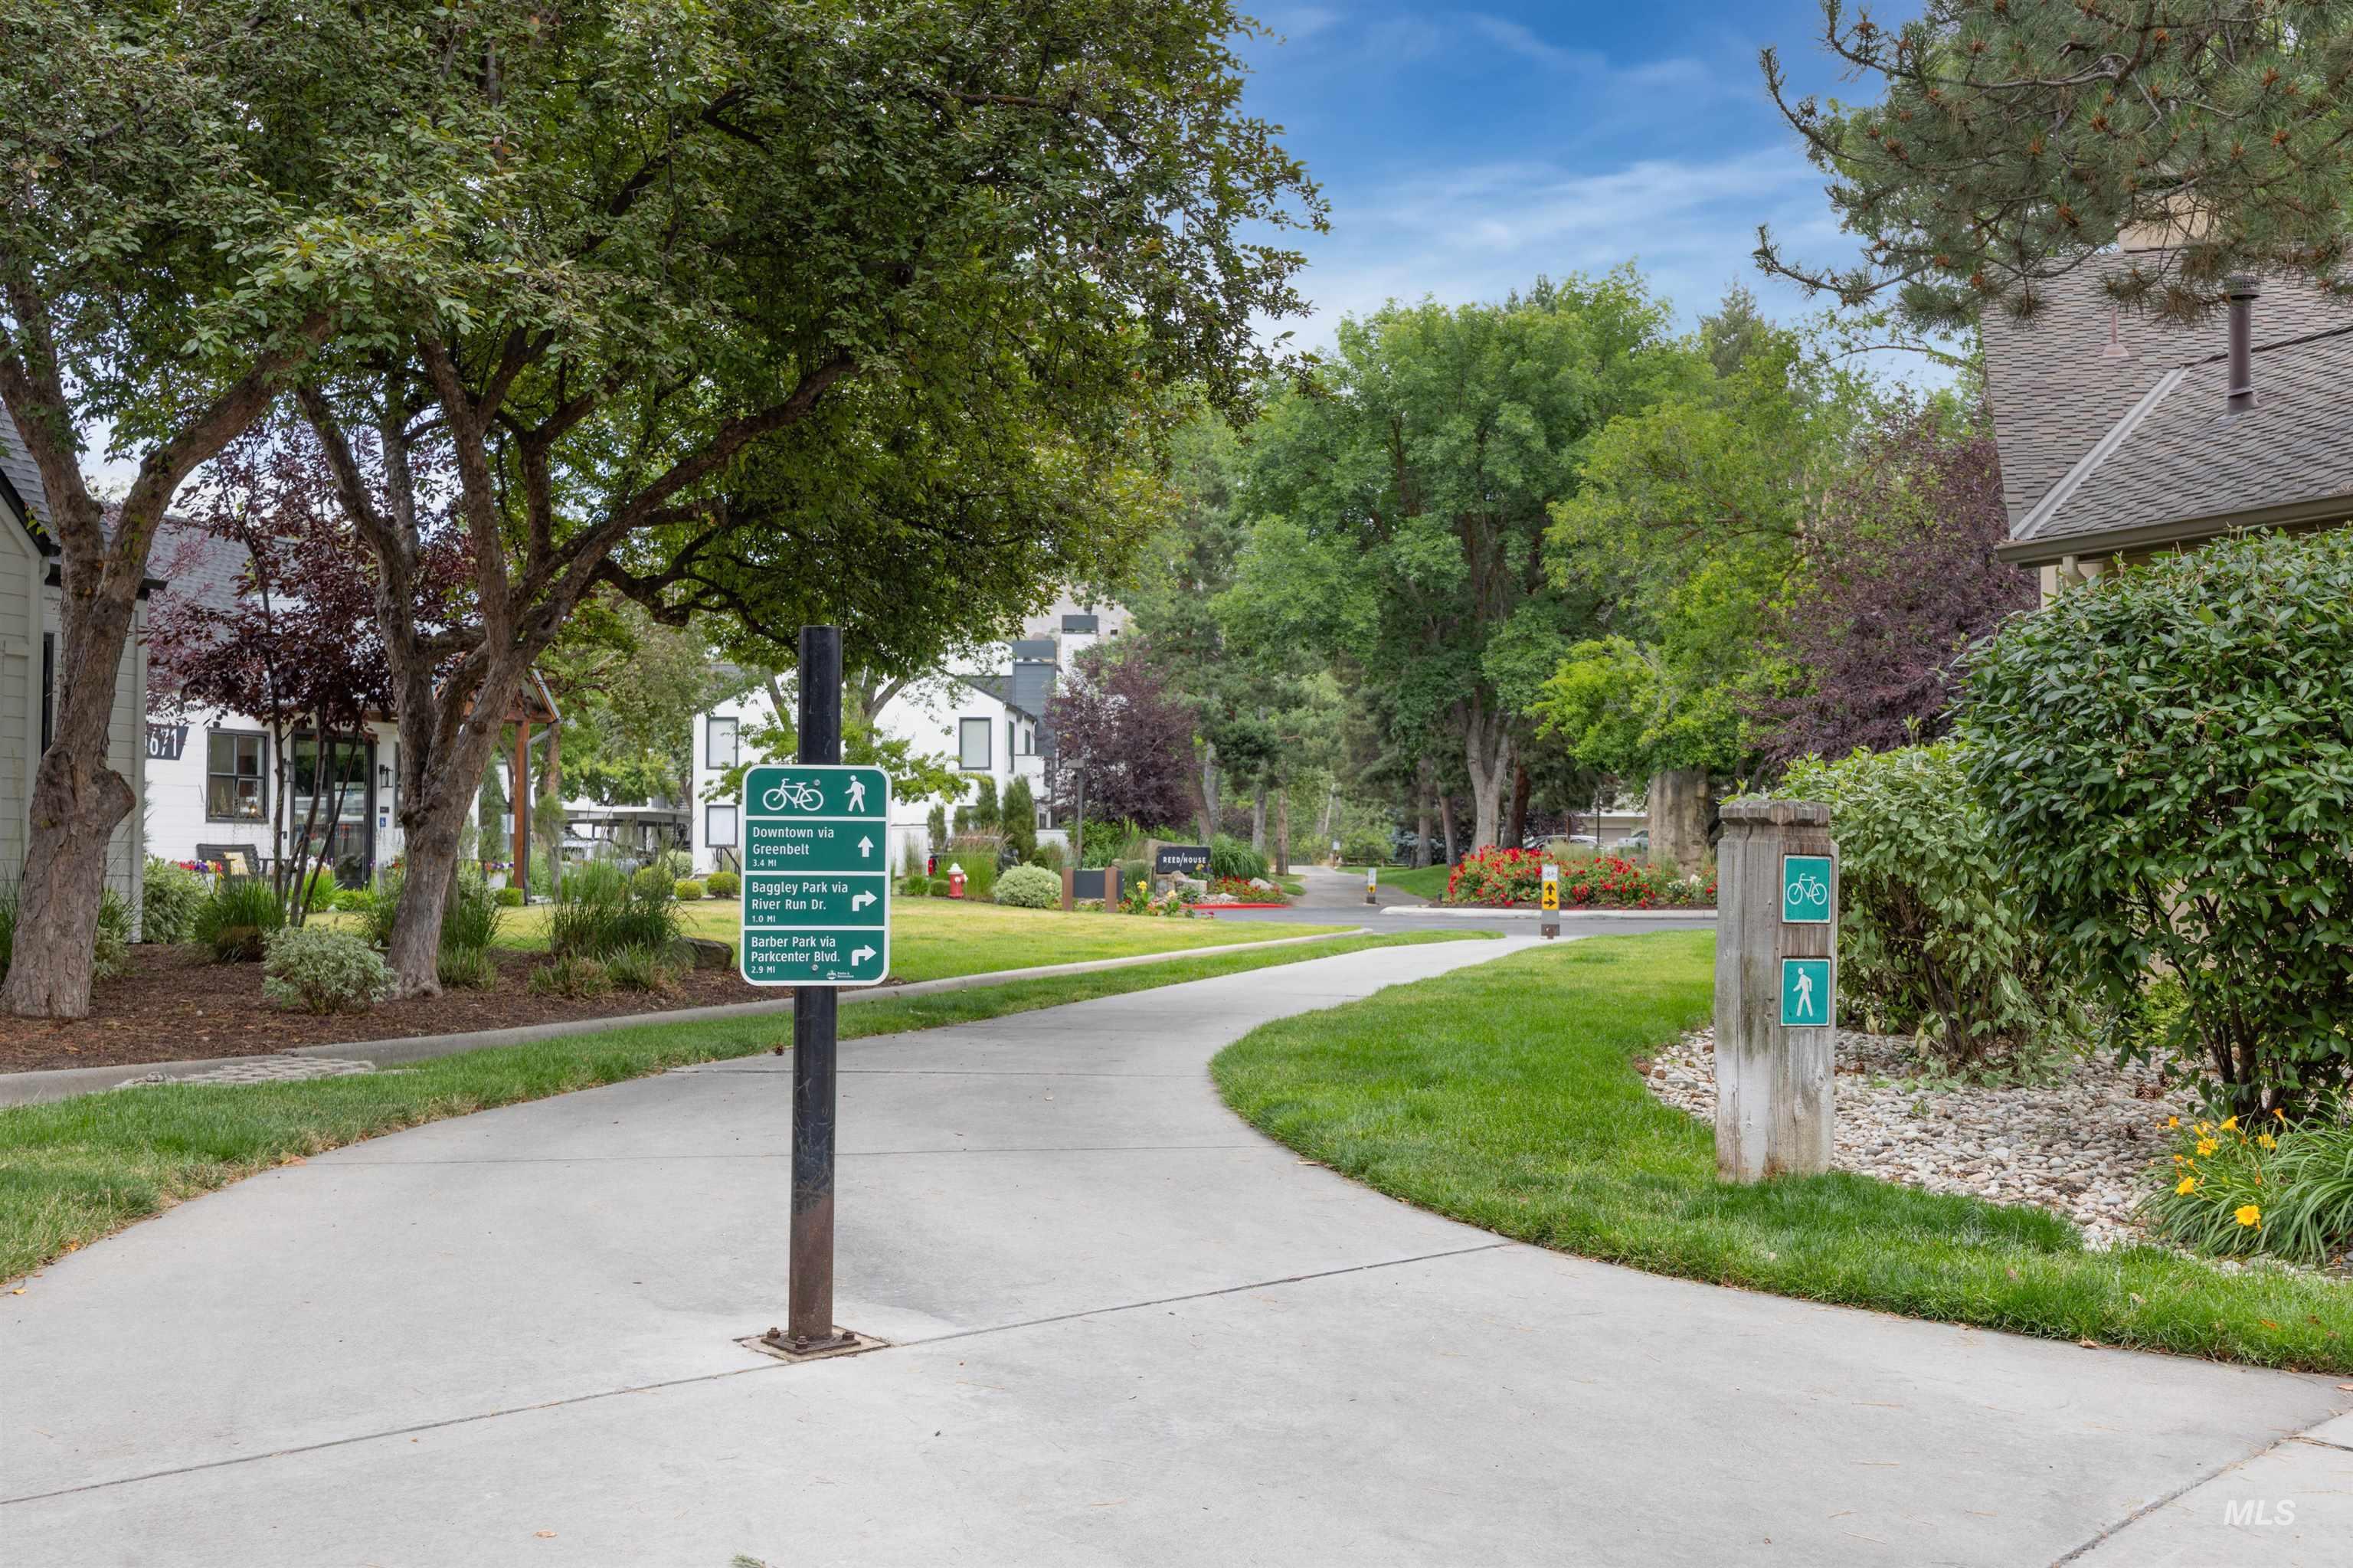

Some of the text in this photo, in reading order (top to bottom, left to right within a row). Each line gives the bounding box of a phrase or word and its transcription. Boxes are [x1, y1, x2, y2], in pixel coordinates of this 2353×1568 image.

[146, 728, 177, 756] 671
[753, 827, 834, 838] Downtown via
[752, 843, 810, 855] Greenbelt
[753, 859, 777, 867] 3.4 MI
[751, 881, 848, 895] Baggley Park via
[751, 899, 827, 910] River Run Dr.
[752, 915, 776, 923] 1.0 MI
[751, 935, 836, 948] Barber Park via
[751, 951, 840, 962] Parkcenter Blvd.
[751, 965, 776, 974] 2.9 MI
